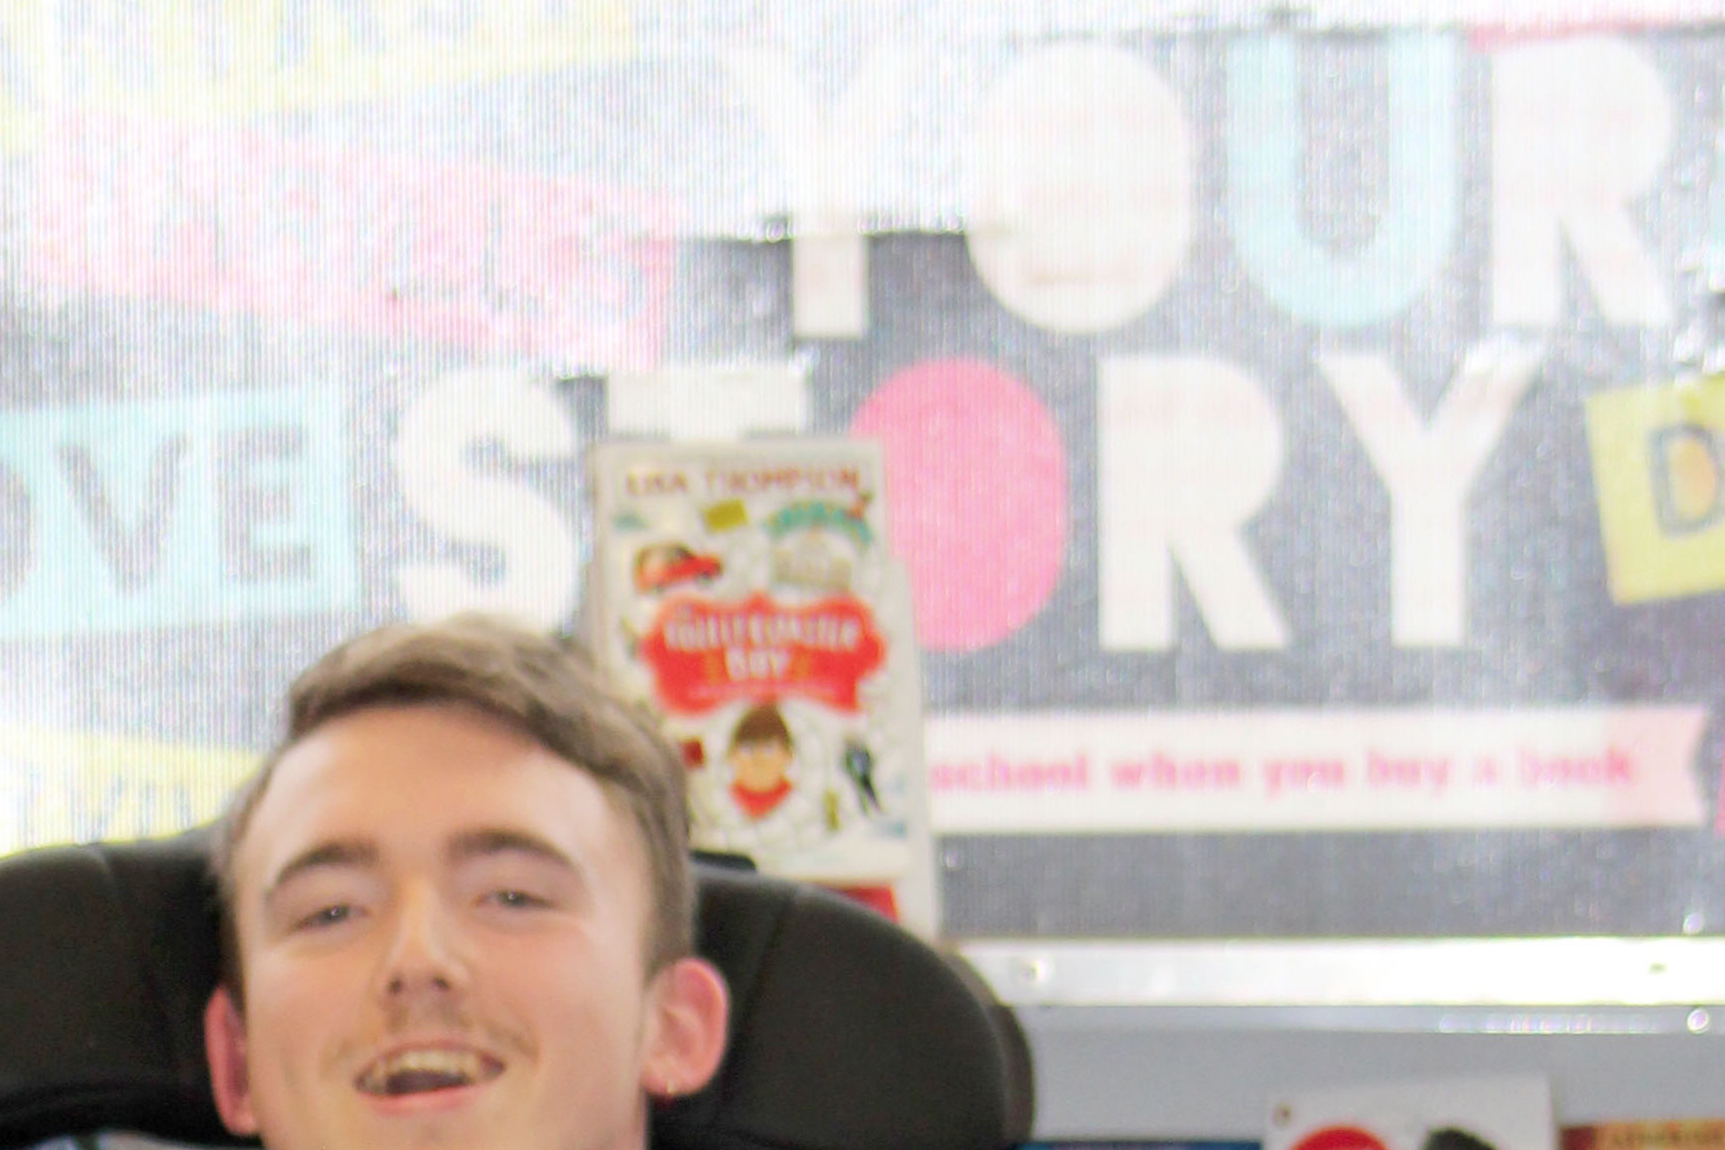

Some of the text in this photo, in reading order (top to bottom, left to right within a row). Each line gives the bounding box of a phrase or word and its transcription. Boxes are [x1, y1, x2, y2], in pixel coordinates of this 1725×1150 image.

[715, 32, 1677, 338] YOUR
[930, 752, 1090, 792] school
[1109, 752, 1241, 790] when
[1262, 756, 1347, 798] you
[1366, 748, 1453, 793] buy
[1517, 746, 1635, 786] book
